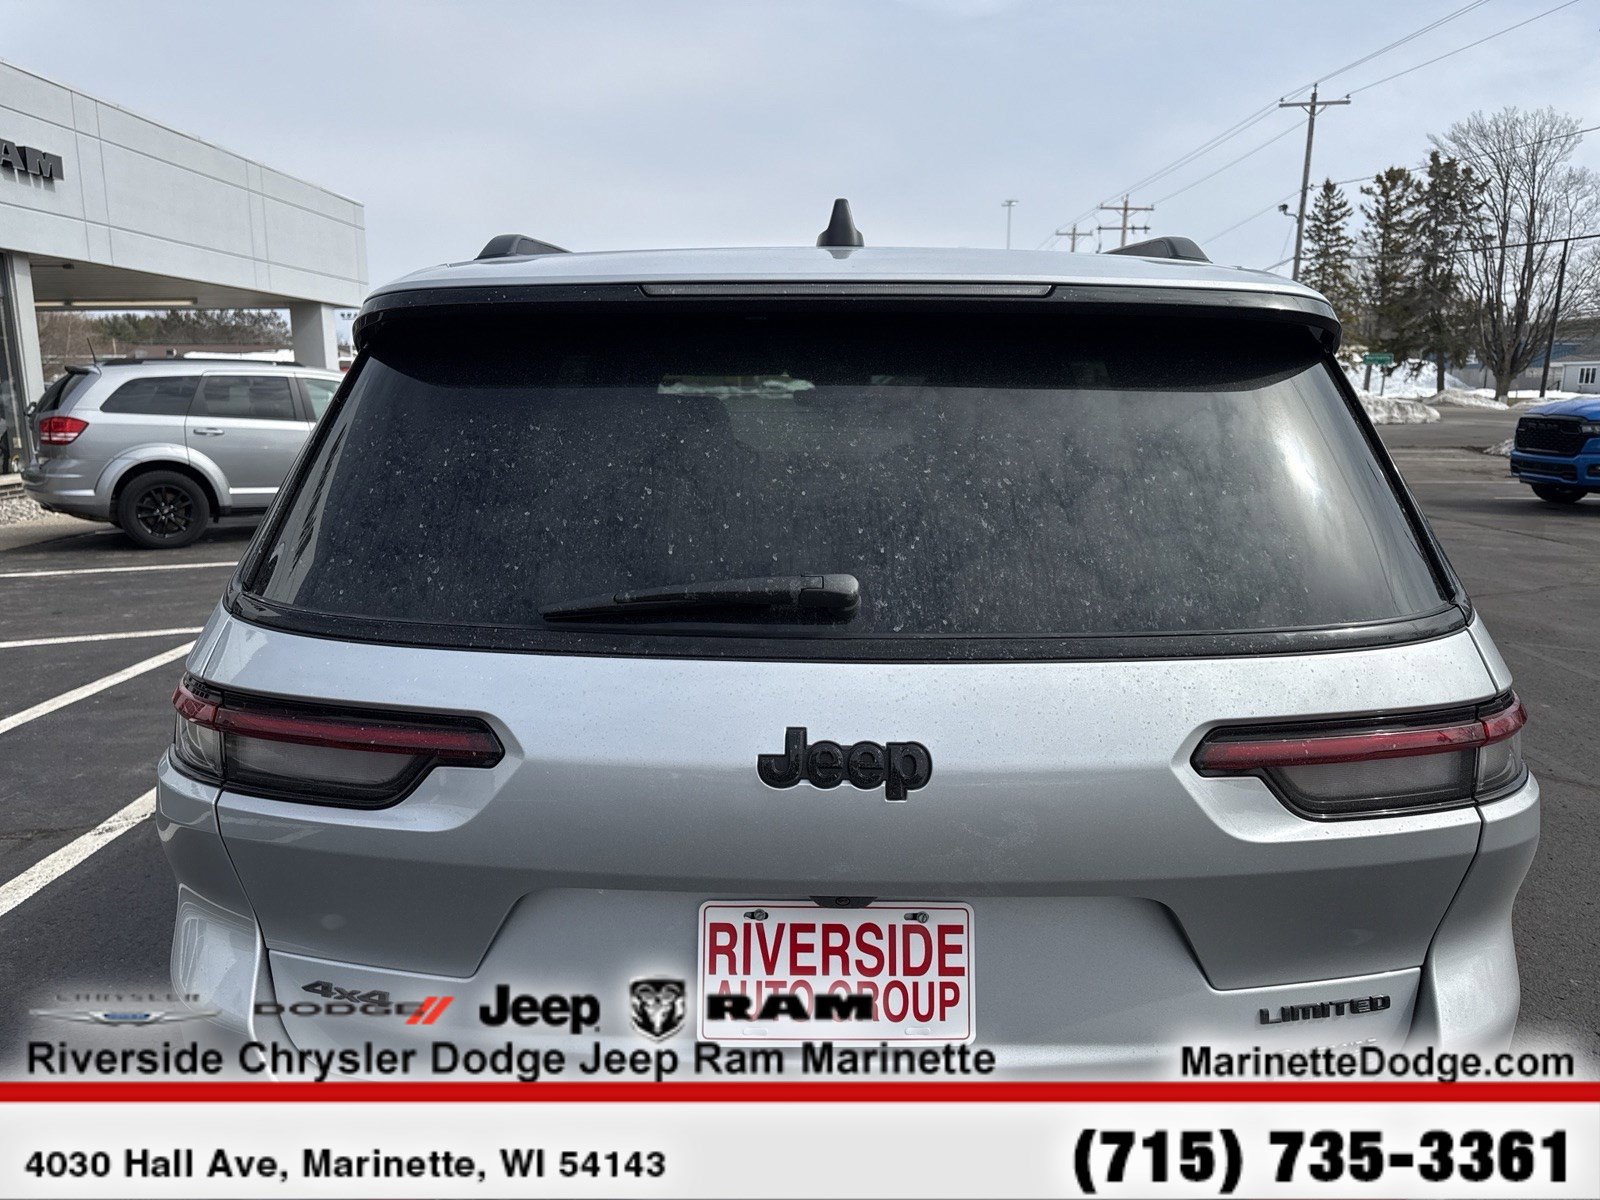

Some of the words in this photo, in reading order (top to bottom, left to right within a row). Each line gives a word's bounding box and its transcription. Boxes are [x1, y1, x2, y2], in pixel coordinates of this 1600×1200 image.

[757, 726, 932, 801] Jeep
[708, 922, 966, 977] RIVERSIDE
[1259, 995, 1392, 1025] LIMITED
